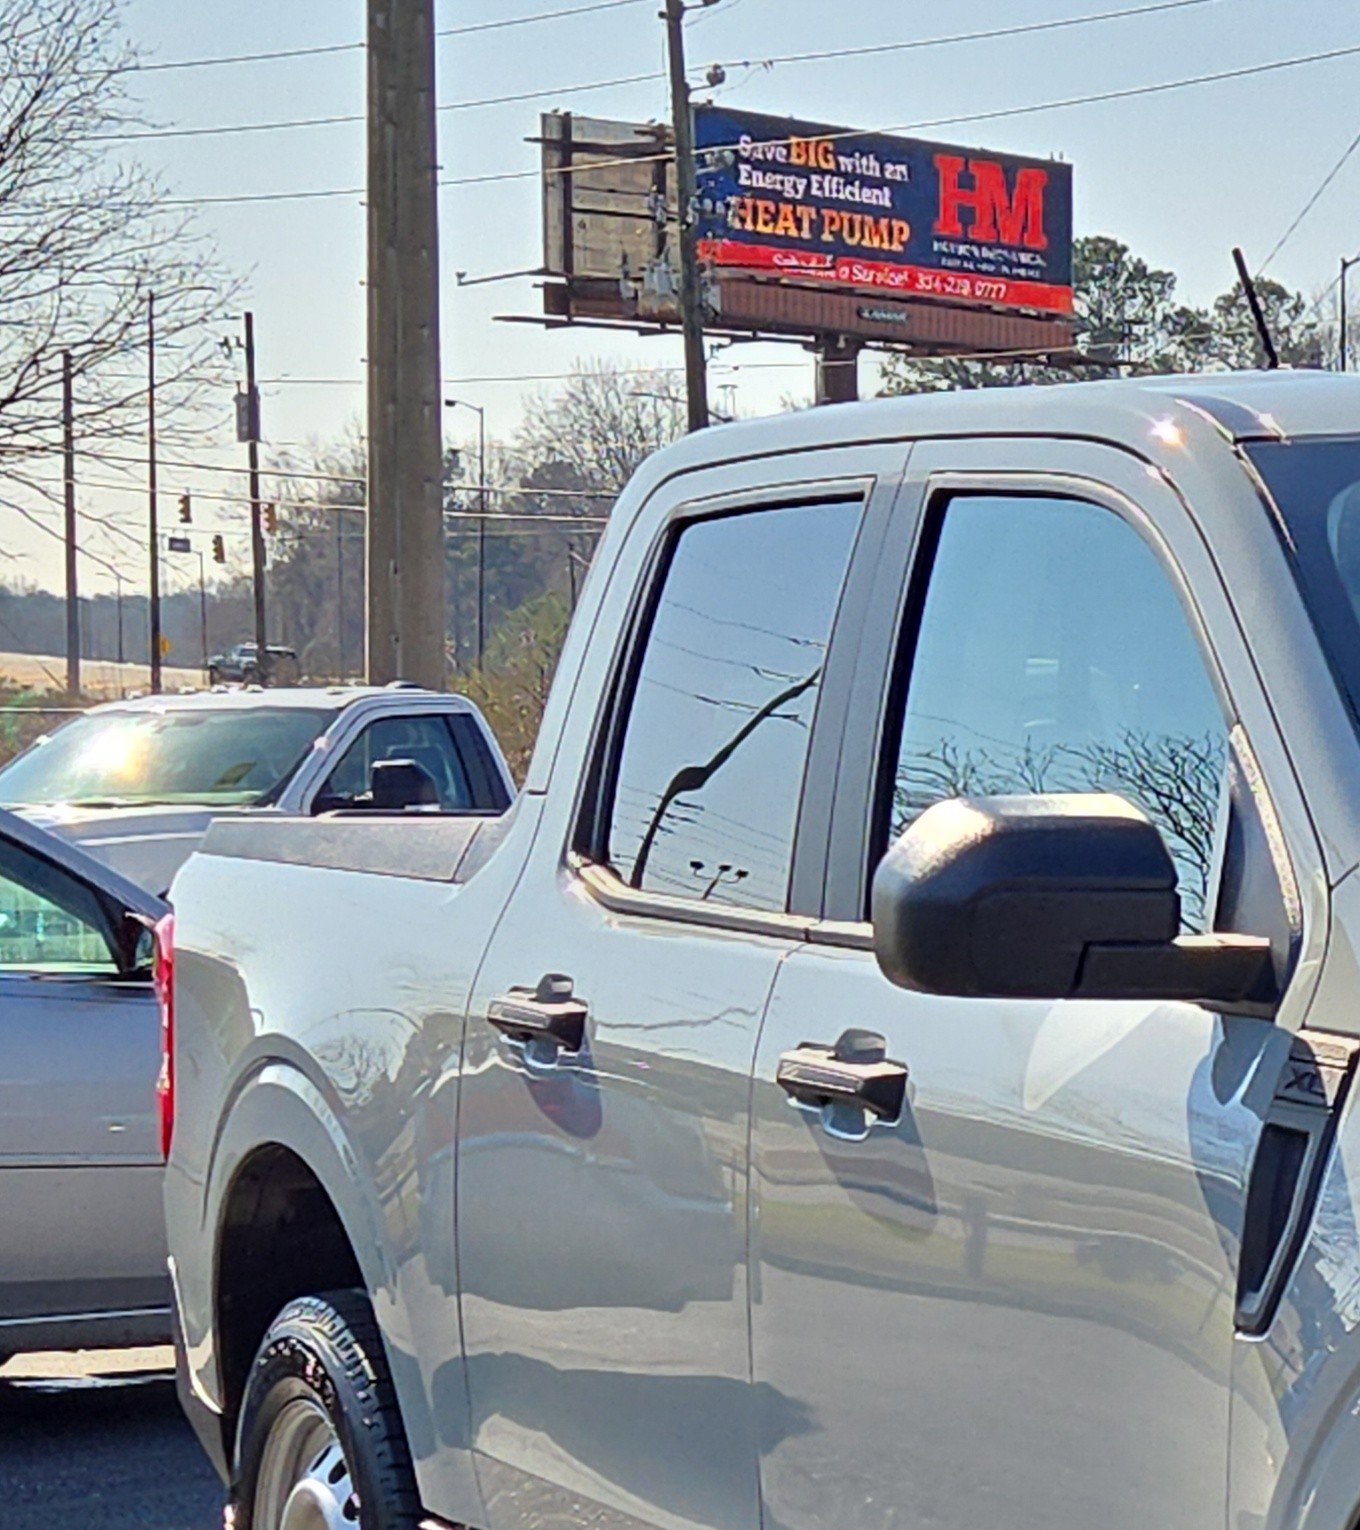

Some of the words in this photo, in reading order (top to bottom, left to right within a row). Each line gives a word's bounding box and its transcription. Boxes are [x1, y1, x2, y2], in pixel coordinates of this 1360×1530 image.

[739, 134, 787, 163] Save
[789, 136, 836, 171] BIG
[837, 152, 881, 178] with
[884, 164, 909, 182] an
[738, 164, 807, 198] Energy
[810, 174, 891, 208] Efficient
[933, 153, 1048, 250] HM
[728, 195, 816, 240] HEAT
[820, 208, 911, 252] PUMP
